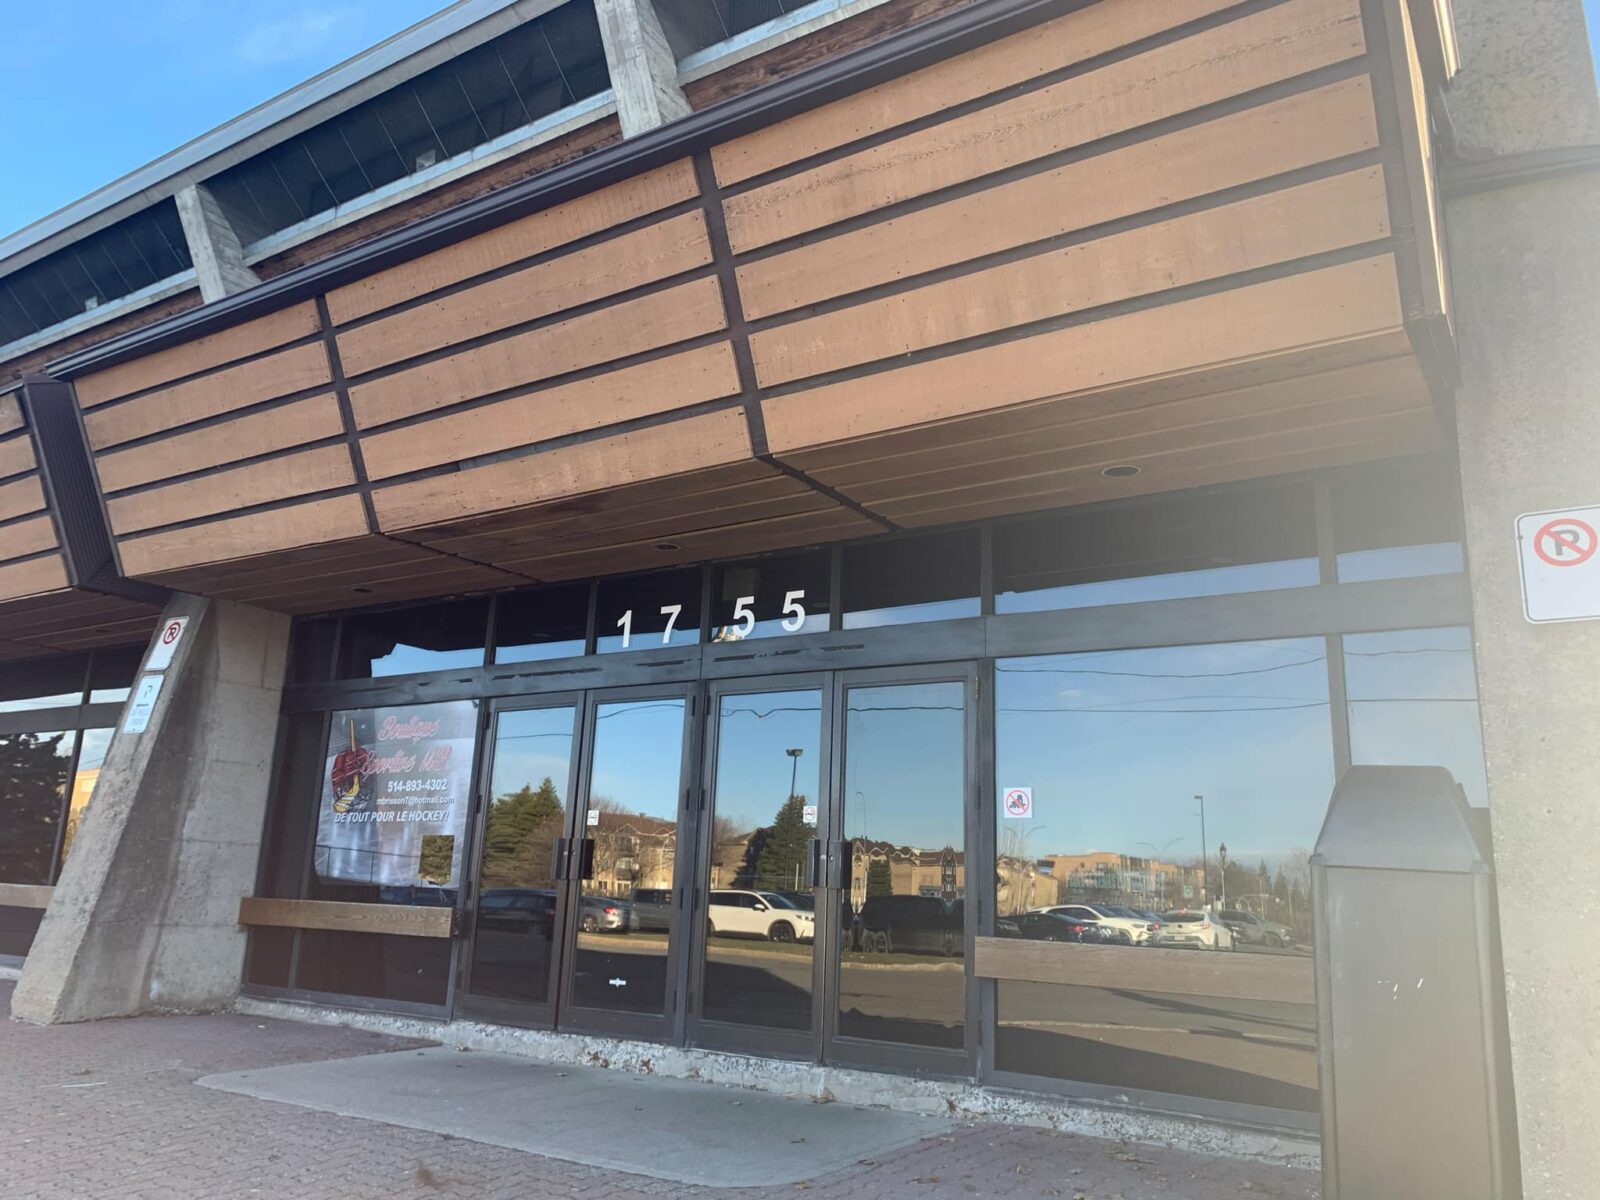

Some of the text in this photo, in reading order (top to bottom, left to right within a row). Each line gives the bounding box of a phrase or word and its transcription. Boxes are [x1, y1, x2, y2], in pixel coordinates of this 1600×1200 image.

[387, 779, 448, 792] 514-893-4302
[334, 813, 347, 823] DE
[348, 812, 369, 823] TOUT
[370, 811, 394, 822] POUR
[396, 811, 407, 822] LE
